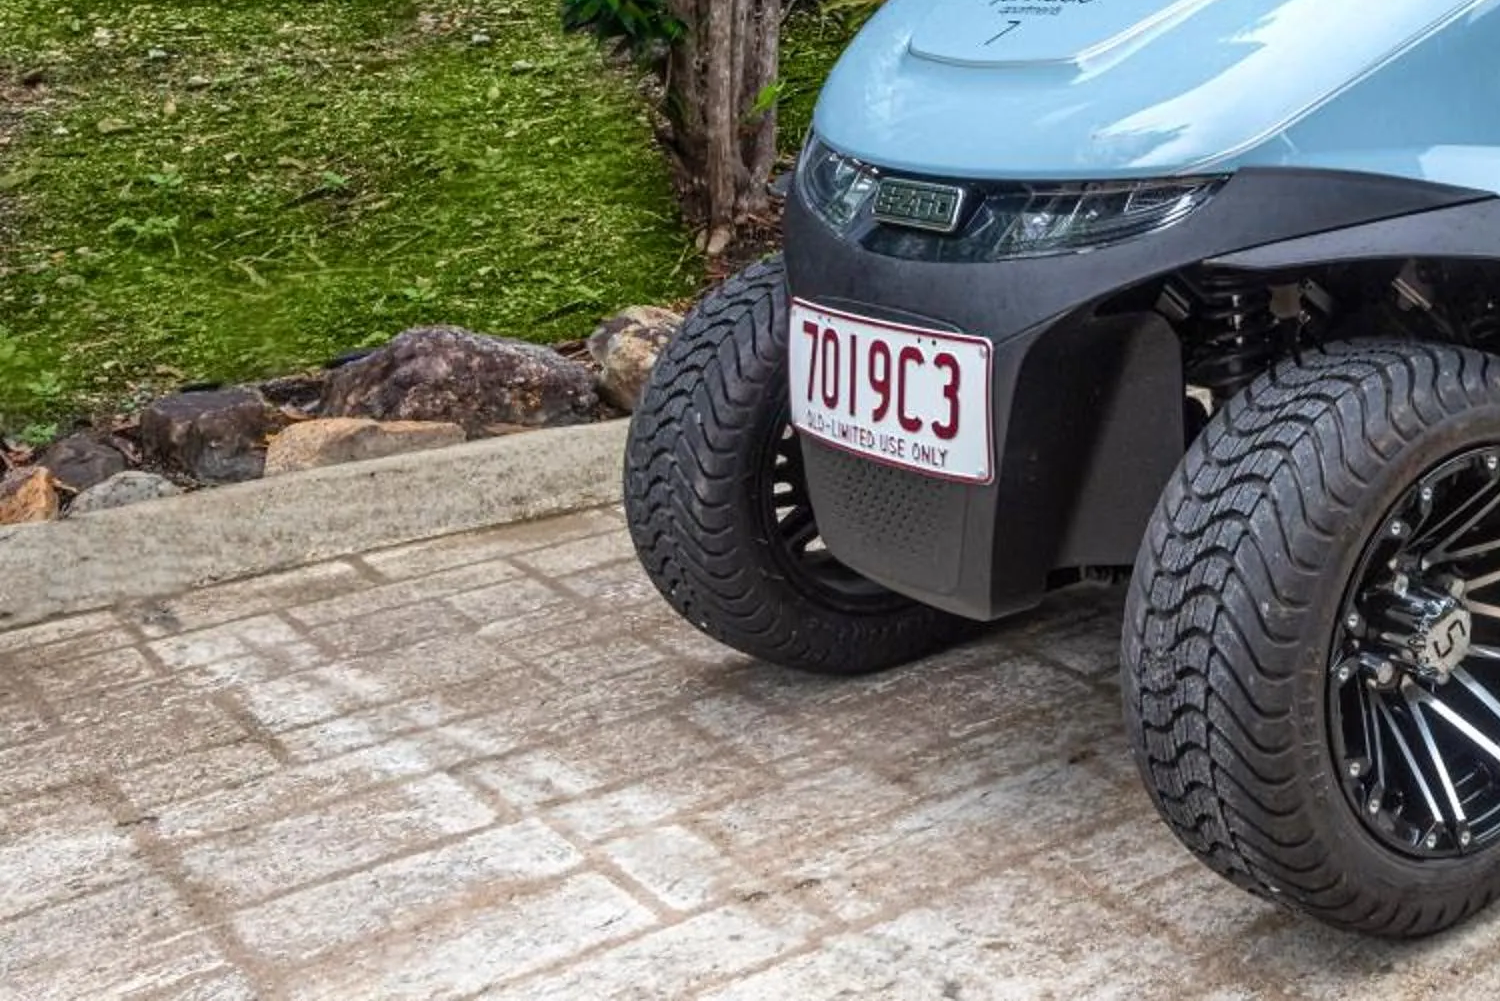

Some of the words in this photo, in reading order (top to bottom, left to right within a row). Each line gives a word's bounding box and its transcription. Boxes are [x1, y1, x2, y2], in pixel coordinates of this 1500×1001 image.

[984, 20, 1021, 46] 7
[803, 320, 961, 440] 7019C3
[880, 434, 906, 458] USE
[911, 442, 949, 467] ONLY
